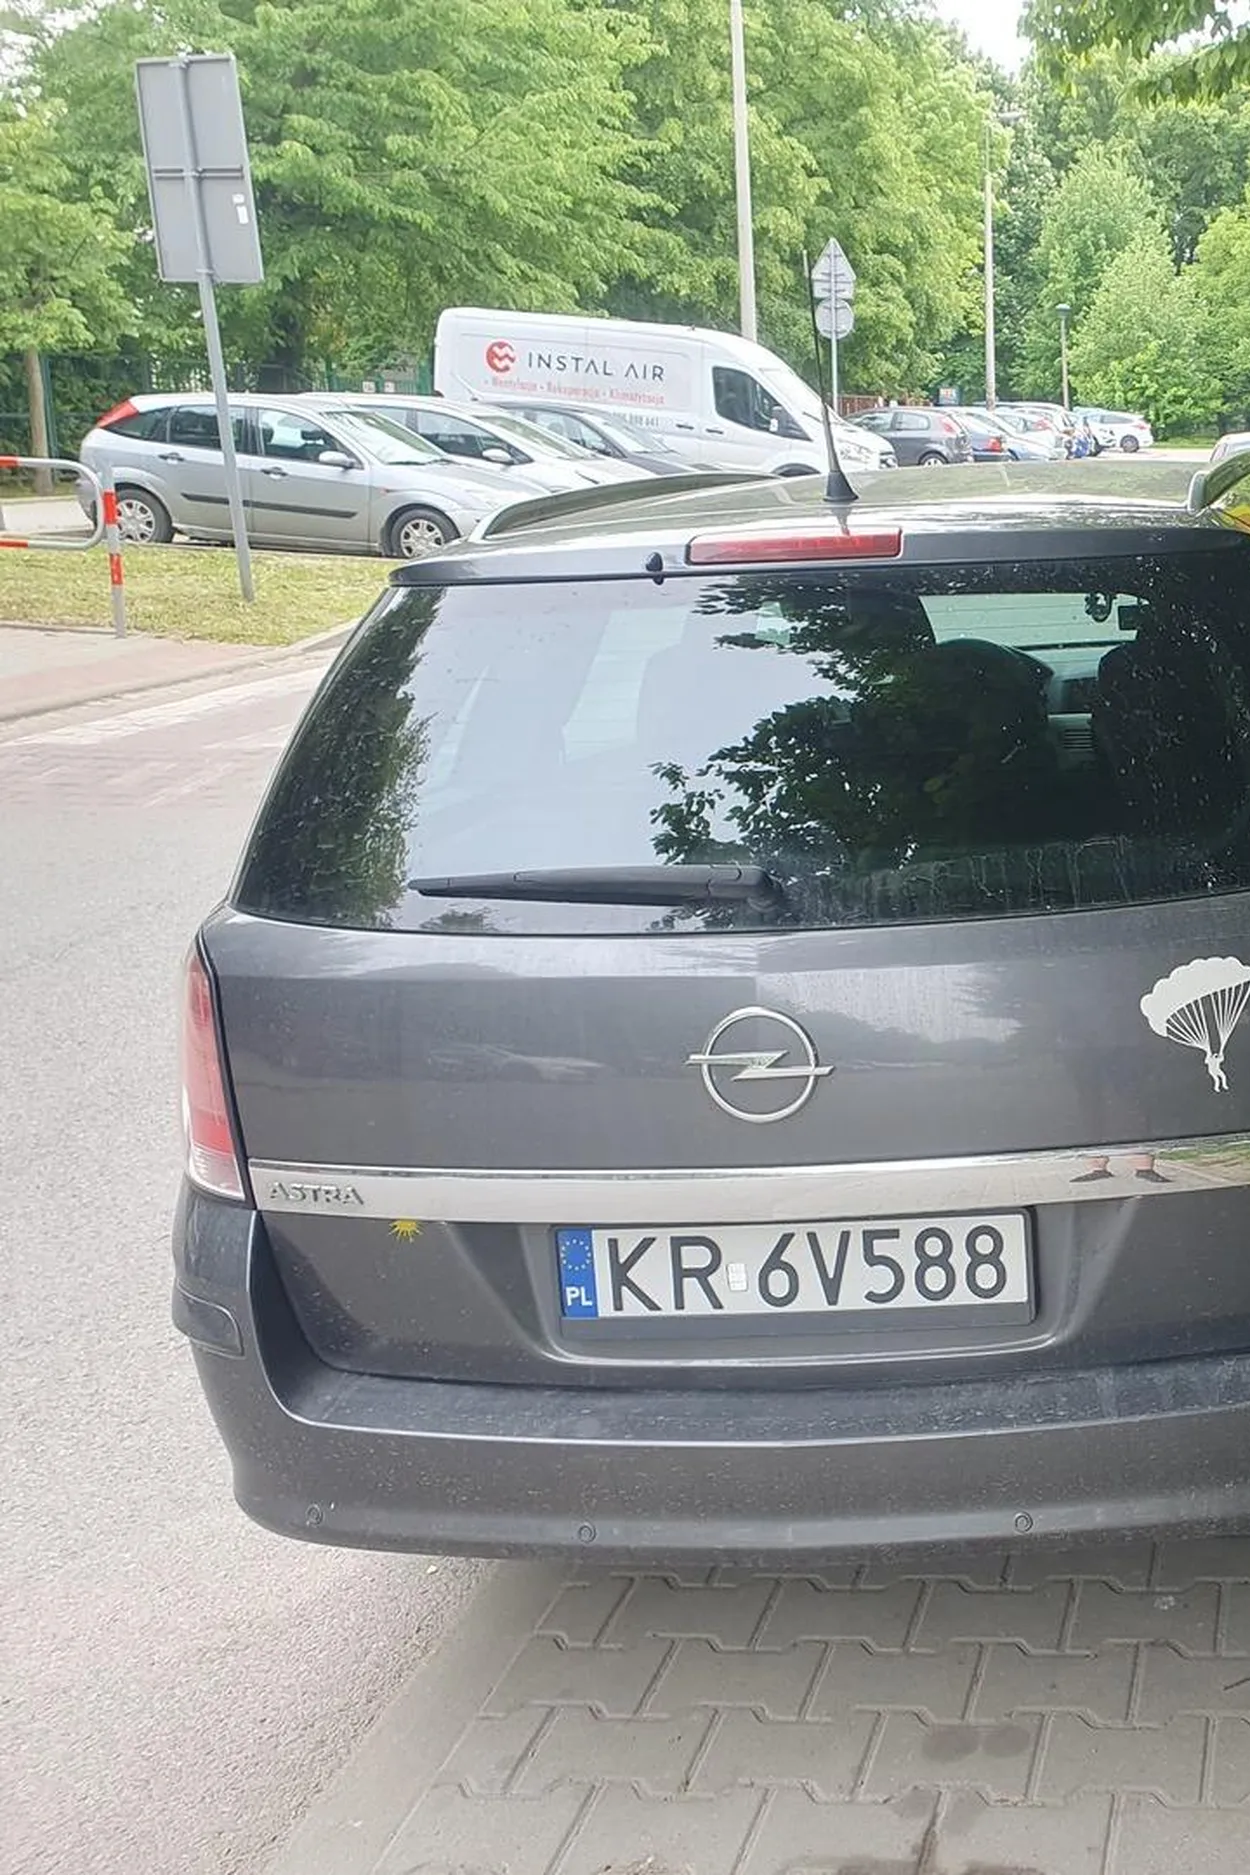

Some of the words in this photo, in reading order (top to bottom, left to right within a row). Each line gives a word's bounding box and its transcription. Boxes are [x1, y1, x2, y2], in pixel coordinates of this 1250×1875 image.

[528, 351, 614, 376] INSTAL
[624, 363, 665, 382] AIR
[270, 1182, 365, 1206] ASTRA
[607, 1235, 725, 1312] KR
[758, 1224, 1007, 1308] 6V588
[565, 1286, 593, 1307] PL
